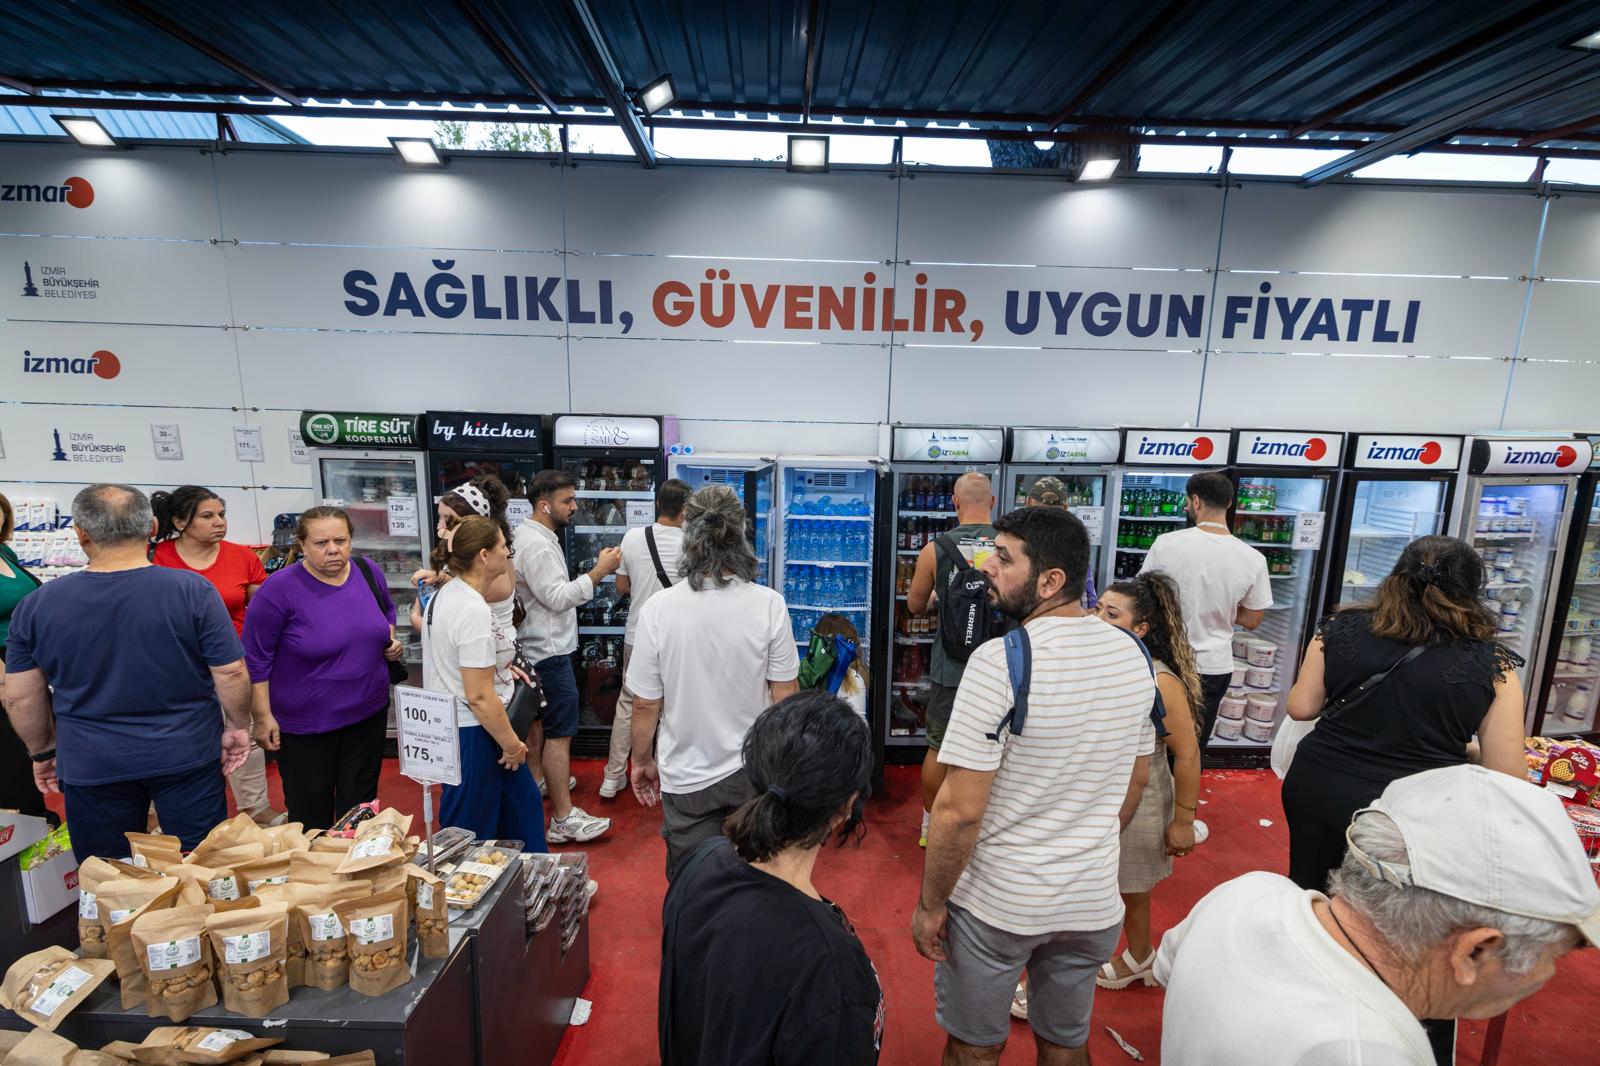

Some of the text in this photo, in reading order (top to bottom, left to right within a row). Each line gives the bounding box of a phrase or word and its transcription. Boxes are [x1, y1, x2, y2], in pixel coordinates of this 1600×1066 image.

[0, 184, 71, 203] zmar
[40, 265, 66, 275] İZMİR
[43, 277, 100, 288] BÜYÜKŞEHİR
[45, 289, 97, 299] BELEDİYESİ
[343, 257, 1421, 344] SAĞLIKLI, GÜVENİLİR, UYGUN FİYATLI
[24, 350, 98, 374] izmar
[344, 416, 410, 434] TİRE SÜT
[433, 420, 536, 441] by kitchen
[69, 432, 94, 441] İZMİR
[345, 434, 413, 444] KOOPERATİFİ
[71, 443, 126, 453] BÜYÜKŞEHİR
[1138, 437, 1197, 456] izmar
[1251, 437, 1310, 457] izmar
[1367, 442, 1426, 460] izmar
[1504, 446, 1561, 465] izmar
[73, 454, 124, 463] BELEDİYESİ
[964, 603, 977, 646] MERRELL
[404, 706, 431, 725] 100,
[403, 744, 433, 764] 175,
